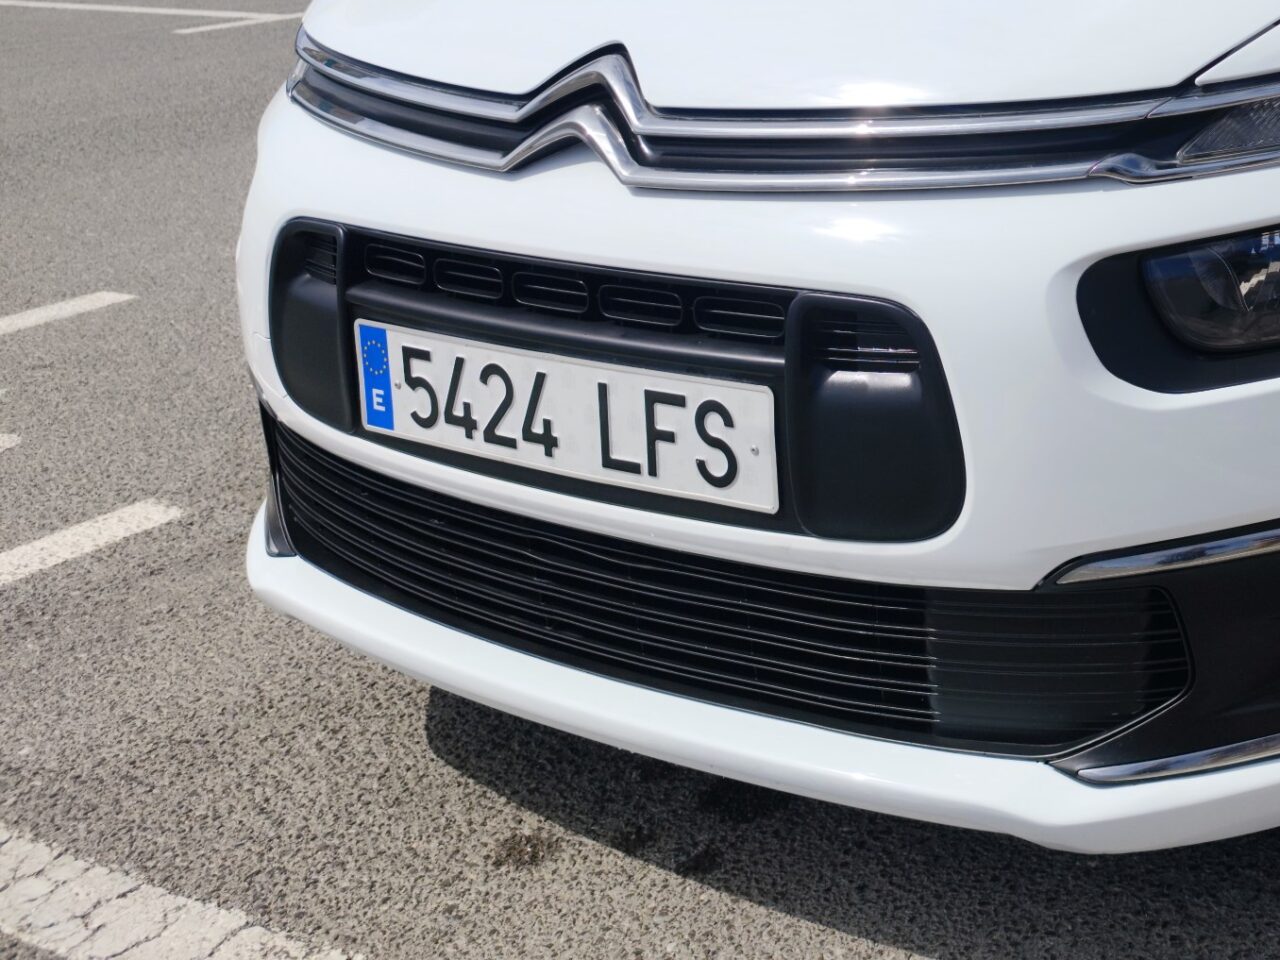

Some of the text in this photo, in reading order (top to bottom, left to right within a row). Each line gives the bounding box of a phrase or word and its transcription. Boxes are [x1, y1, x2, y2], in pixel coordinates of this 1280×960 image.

[372, 388, 386, 412] E
[401, 345, 738, 489] 5424 LFS
